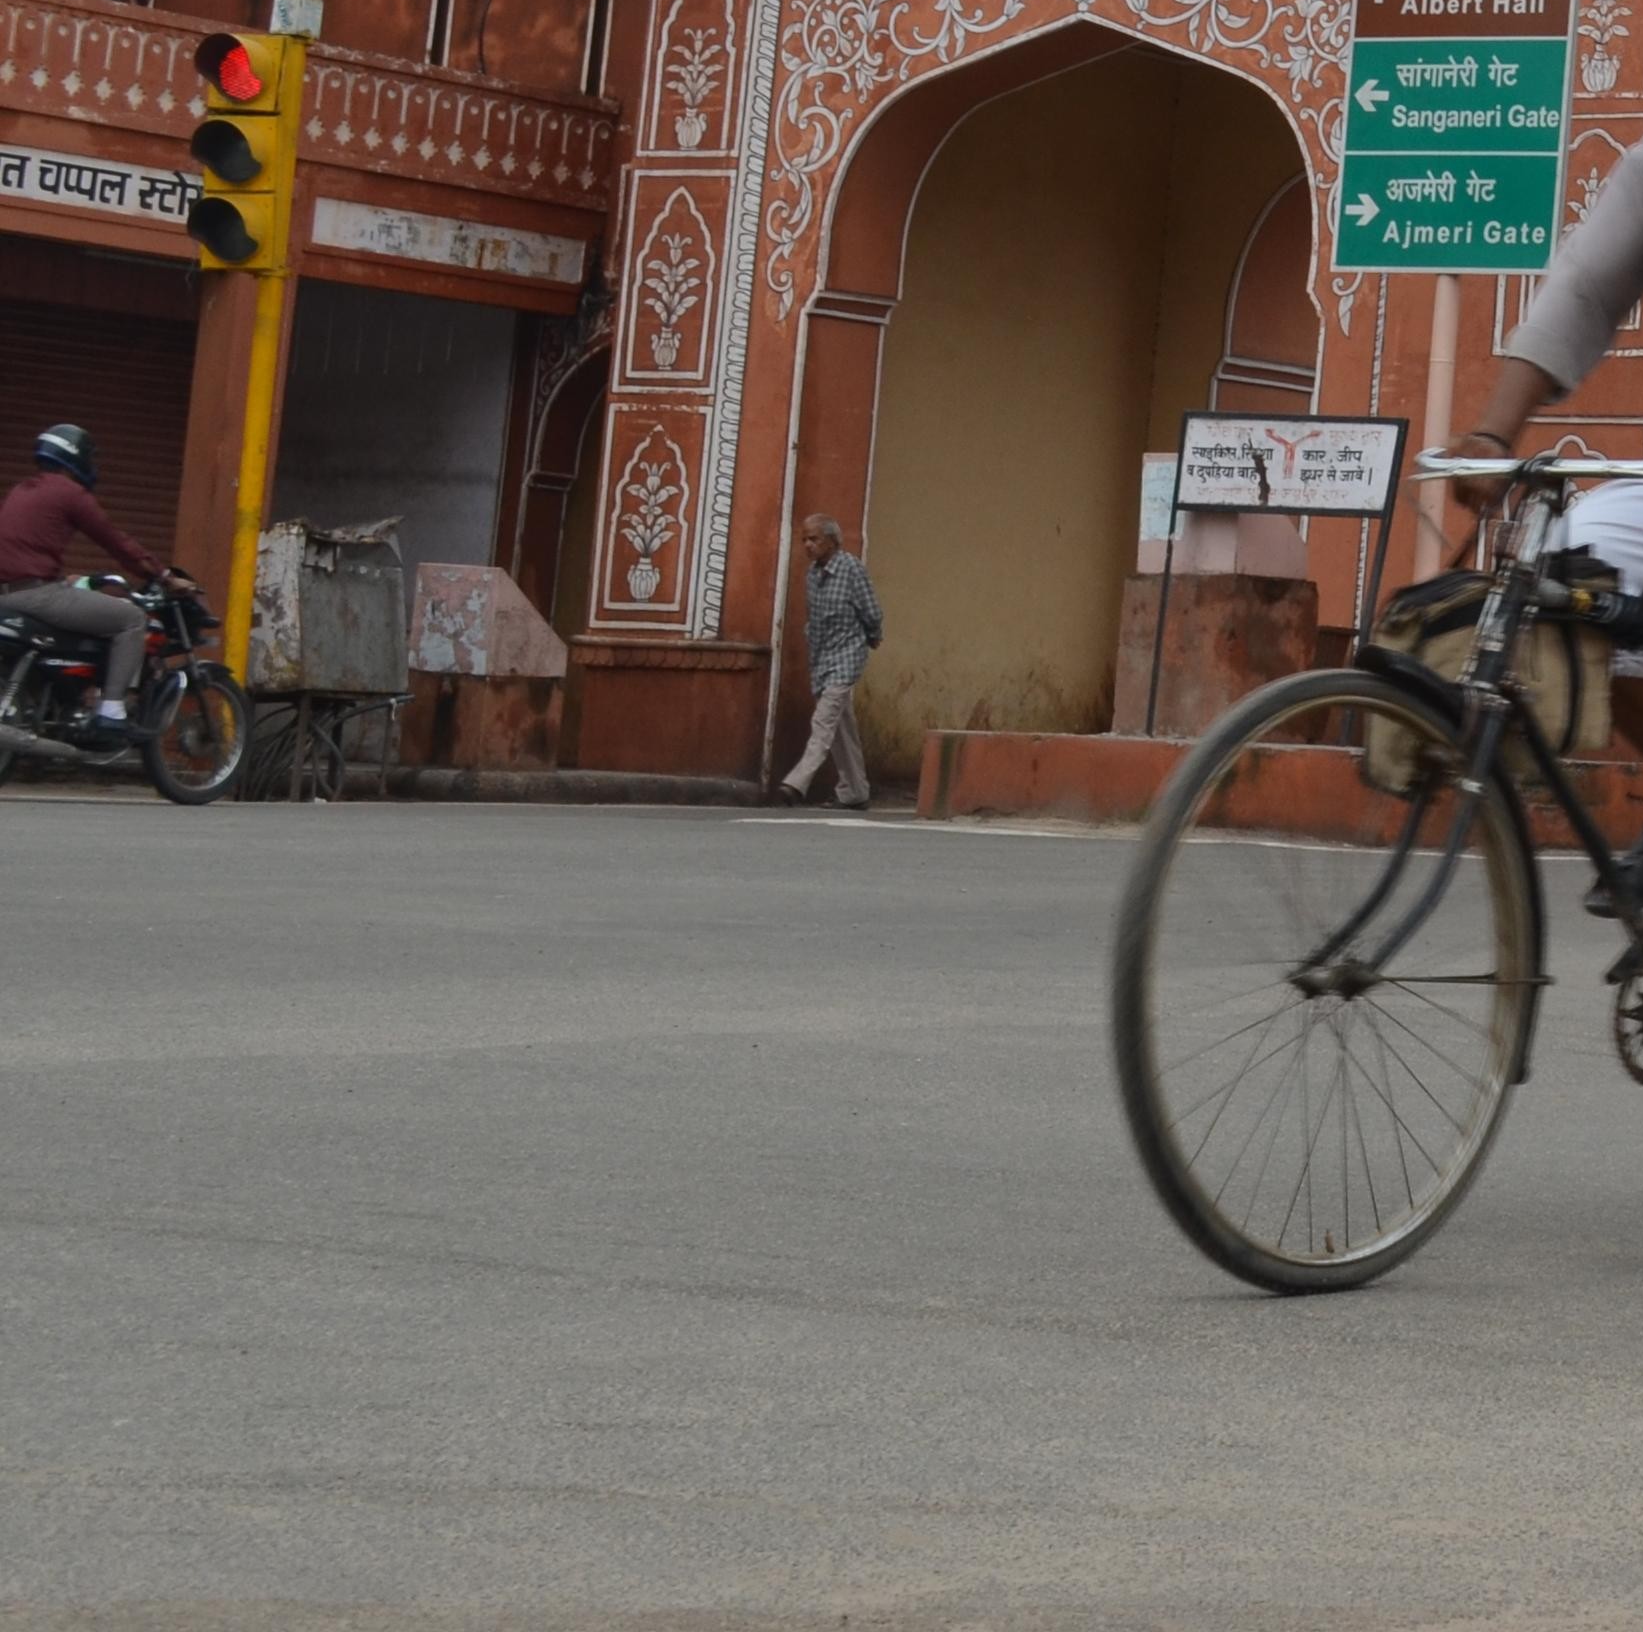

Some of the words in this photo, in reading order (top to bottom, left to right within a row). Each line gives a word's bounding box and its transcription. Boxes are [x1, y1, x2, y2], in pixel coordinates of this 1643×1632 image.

[1396, 55, 1479, 88] सांगानेरी
[1488, 54, 1519, 87] गेट
[1391, 105, 1501, 133] Sanganeri
[1508, 106, 1559, 128] Gate
[39, 159, 132, 205] चप्पल
[1386, 170, 1456, 203] अजमेरी
[1466, 170, 1496, 202] गेट
[1382, 221, 1472, 249] Ajmeri
[1483, 222, 1545, 244] Gate
[1336, 445, 1363, 462] जीप
[1326, 465, 1337, 481] से
